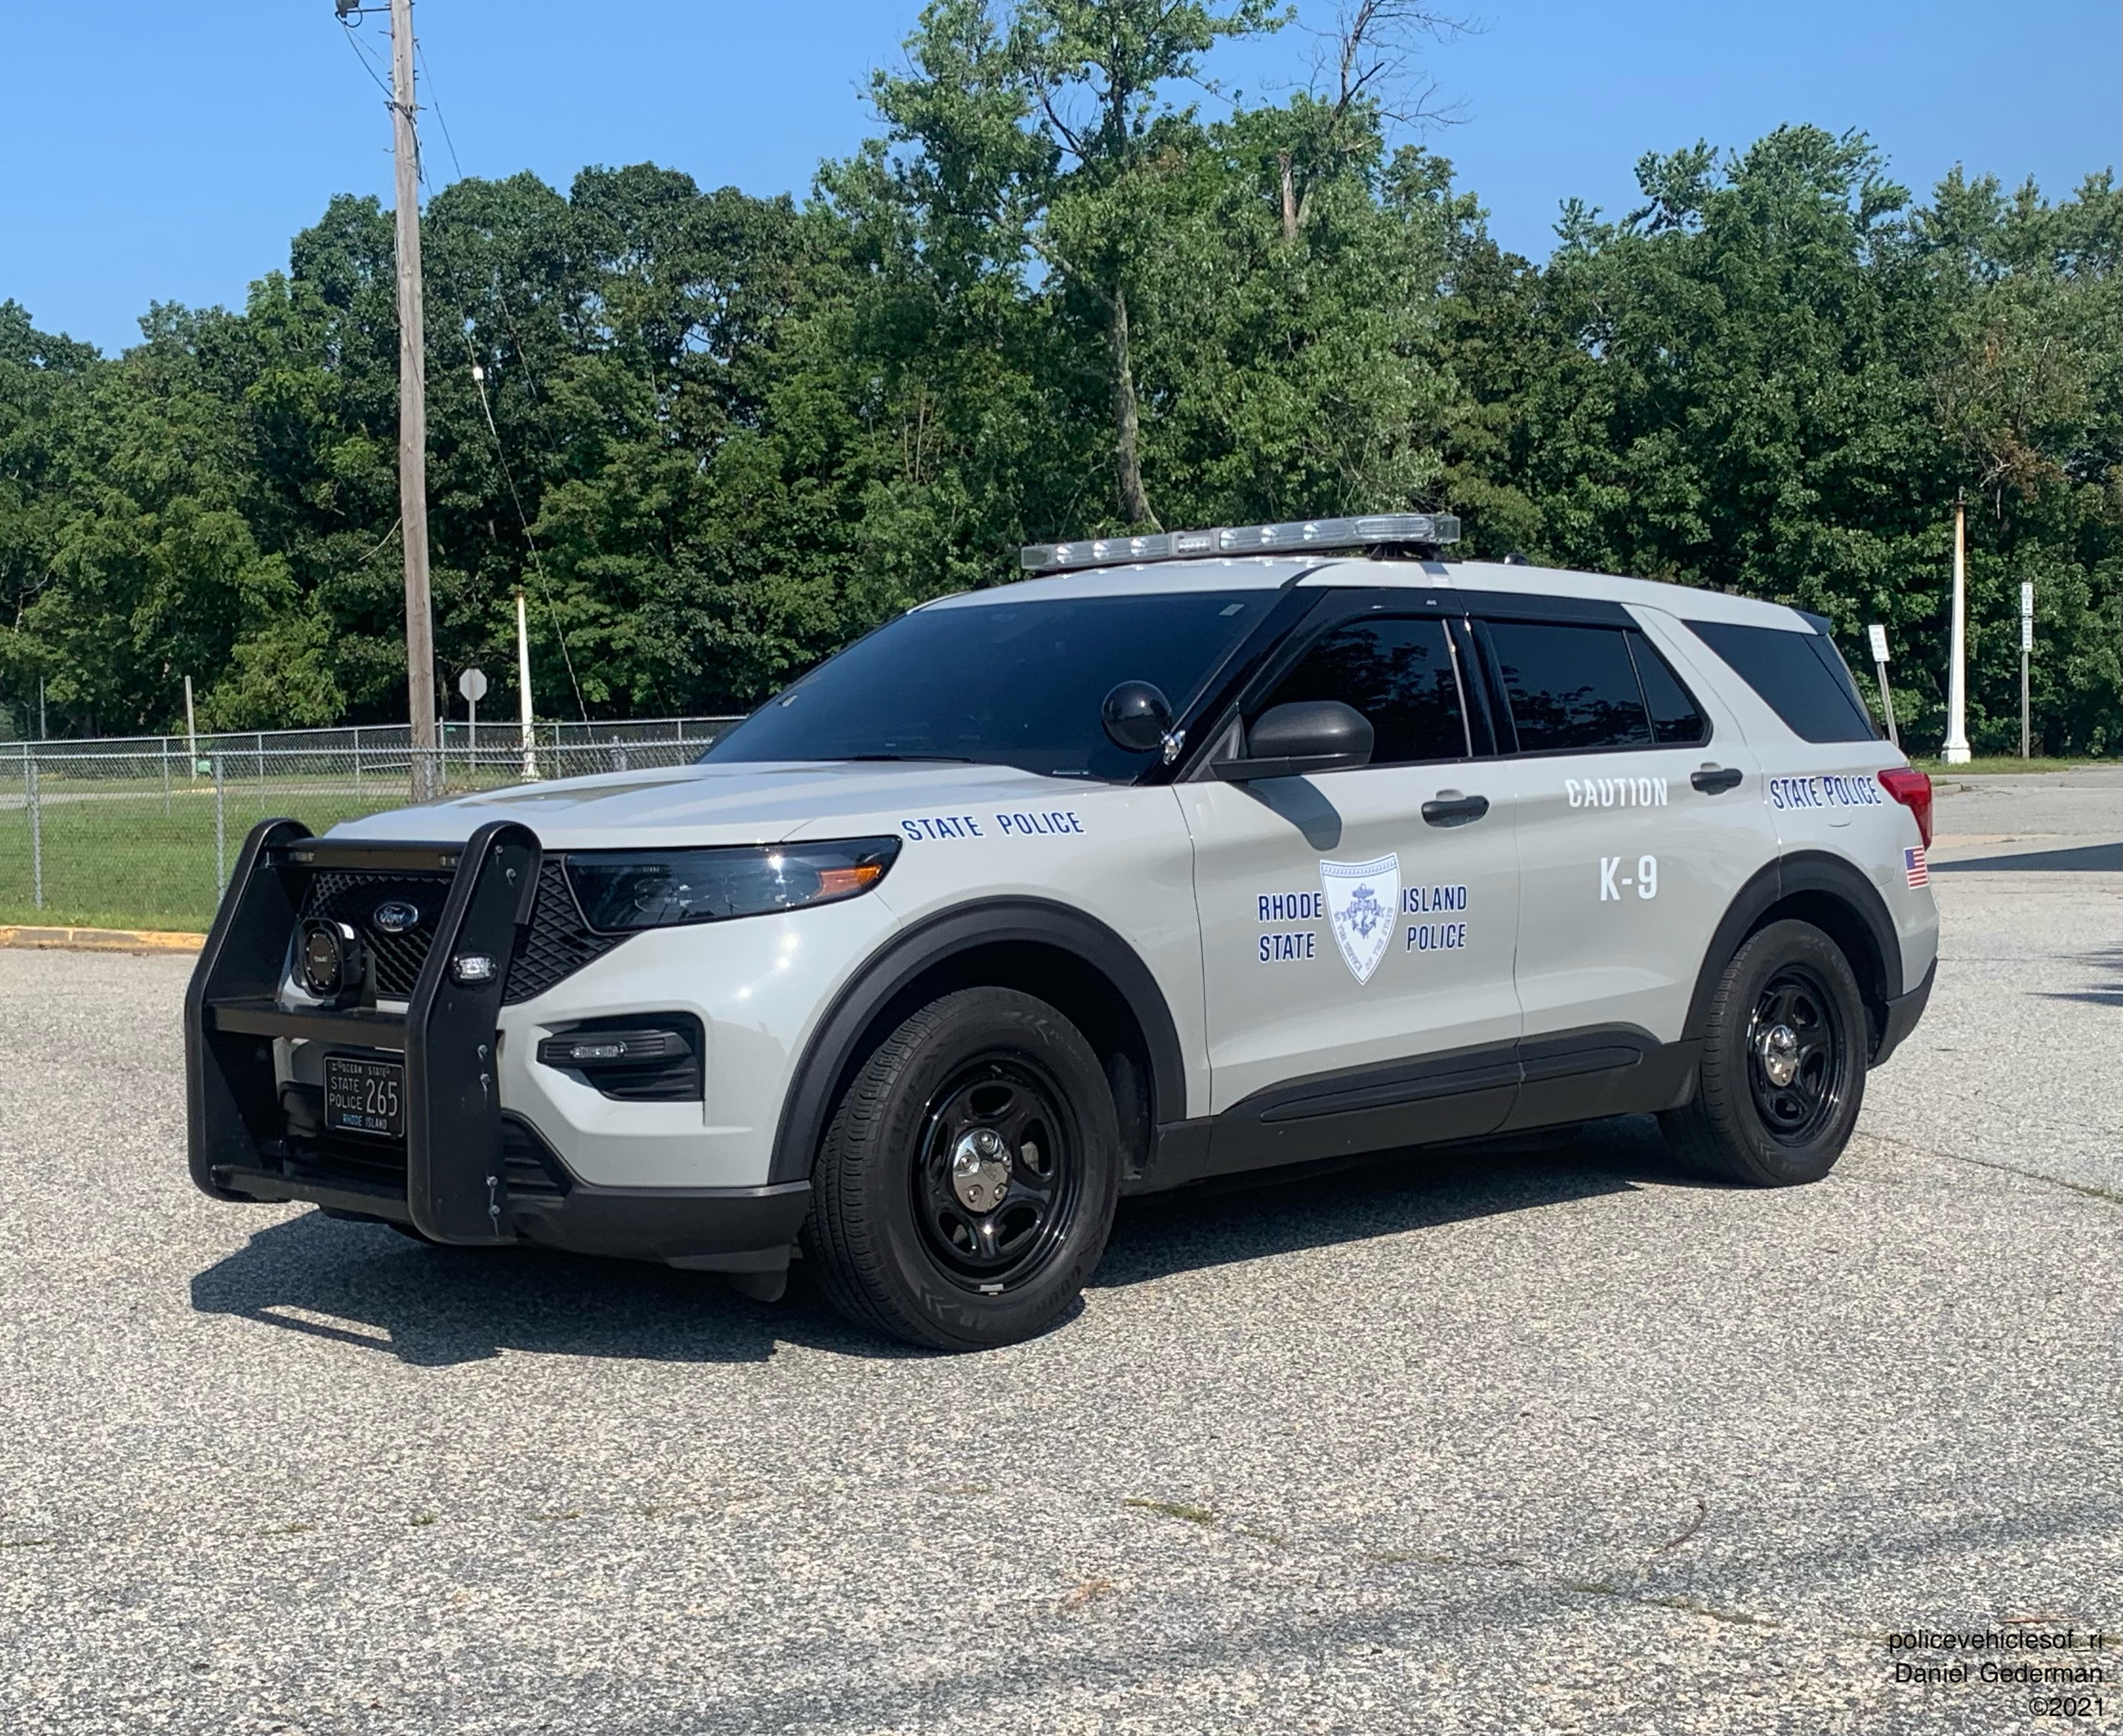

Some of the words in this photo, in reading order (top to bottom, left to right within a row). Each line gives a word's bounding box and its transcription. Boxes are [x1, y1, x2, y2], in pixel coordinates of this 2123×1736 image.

[1565, 778, 1668, 807] CAUTION
[1770, 777, 1823, 810] STATE
[1824, 776, 1882, 807] POLICE
[900, 815, 984, 841] STATE
[996, 811, 1085, 835] POLICE
[1600, 855, 1657, 901] K-9
[380, 906, 406, 926] Ford
[1258, 892, 1323, 921] RHODE
[1403, 885, 1467, 913] ISLAND
[1259, 933, 1315, 962] STATE
[1406, 923, 1466, 952] POLICE
[342, 1062, 362, 1074] OCEAN
[368, 1066, 386, 1077] STATE
[331, 1076, 360, 1093] STATE
[366, 1078, 398, 1117] 265
[329, 1093, 362, 1110] POLICE
[342, 1114, 362, 1127] RHODE
[365, 1117, 387, 1129] ISLAND
